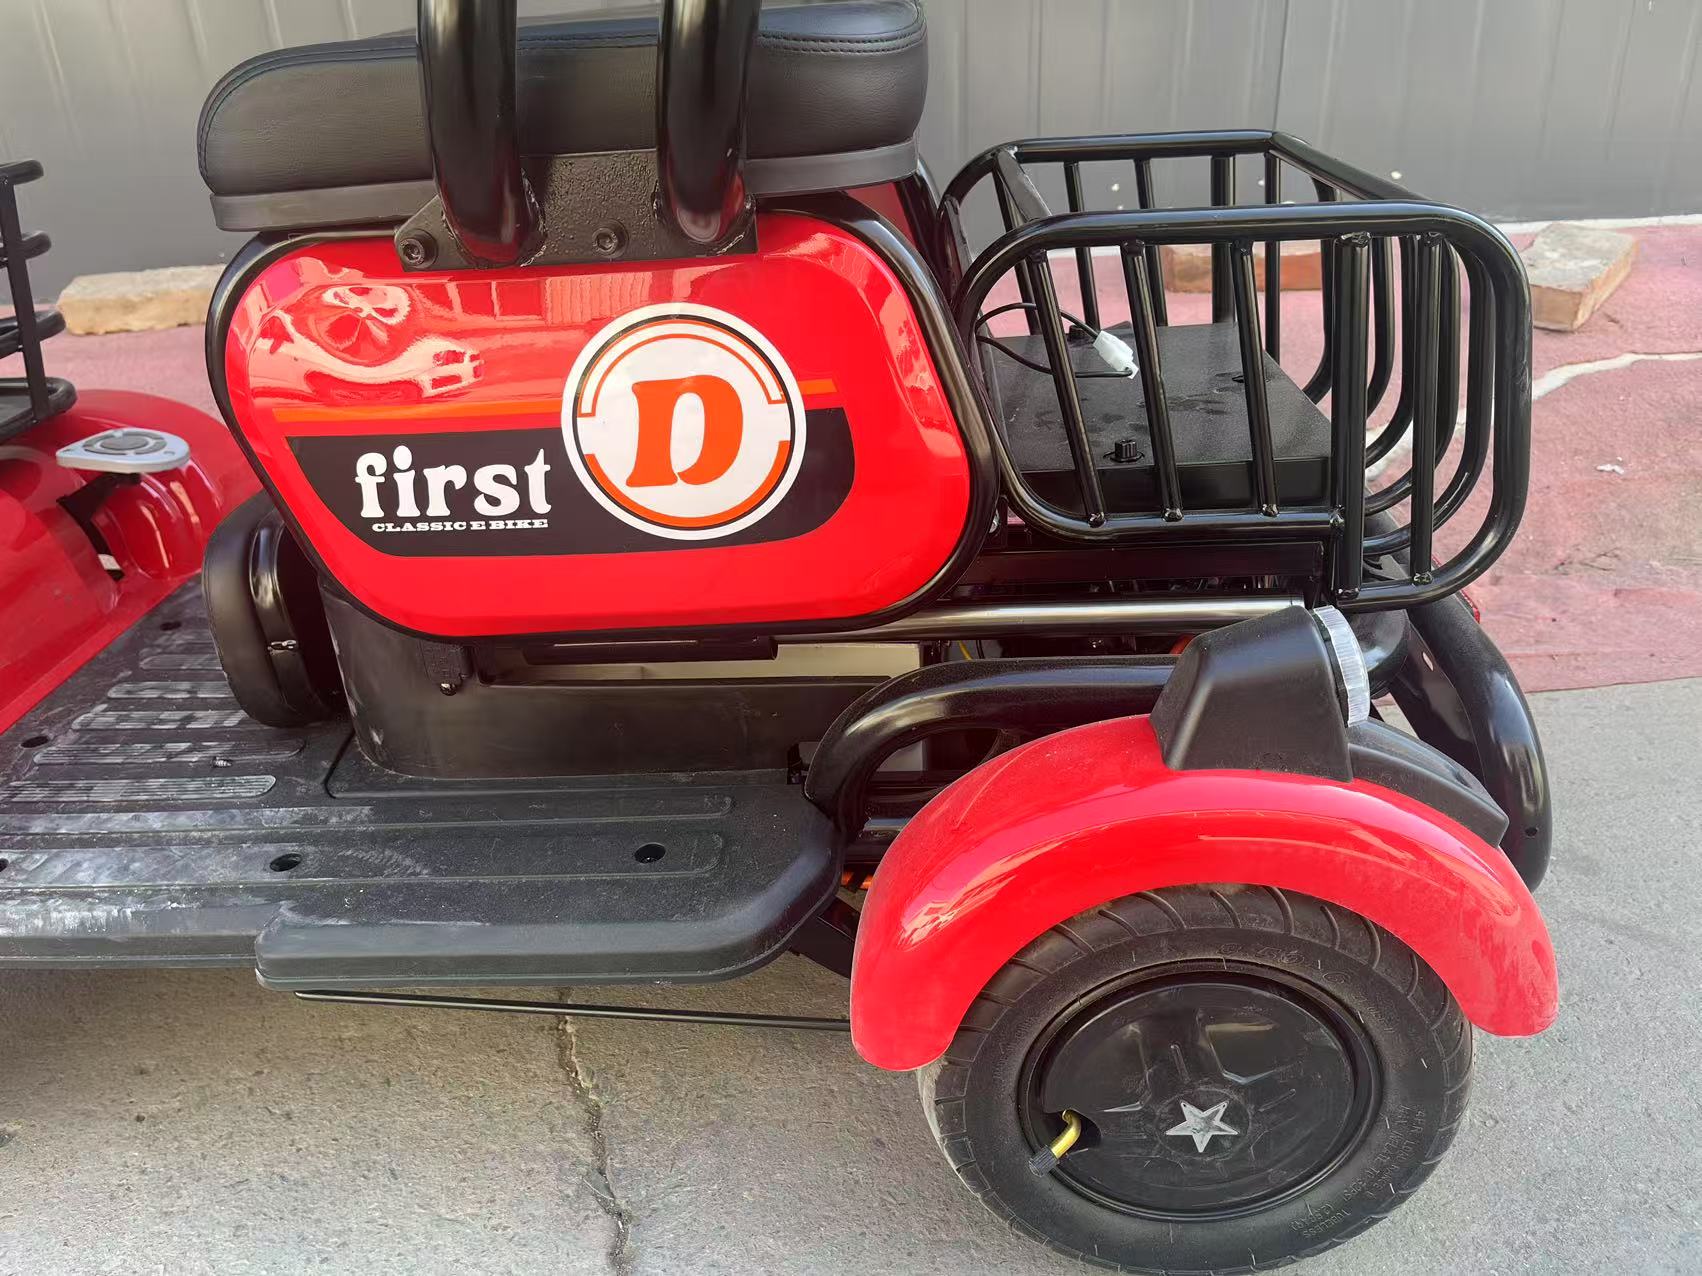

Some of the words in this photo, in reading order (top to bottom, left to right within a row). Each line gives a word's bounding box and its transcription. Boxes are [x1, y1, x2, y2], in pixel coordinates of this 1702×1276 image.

[354, 445, 552, 518] first
[372, 521, 467, 532] CLASSIC
[489, 519, 548, 530] BIKE
